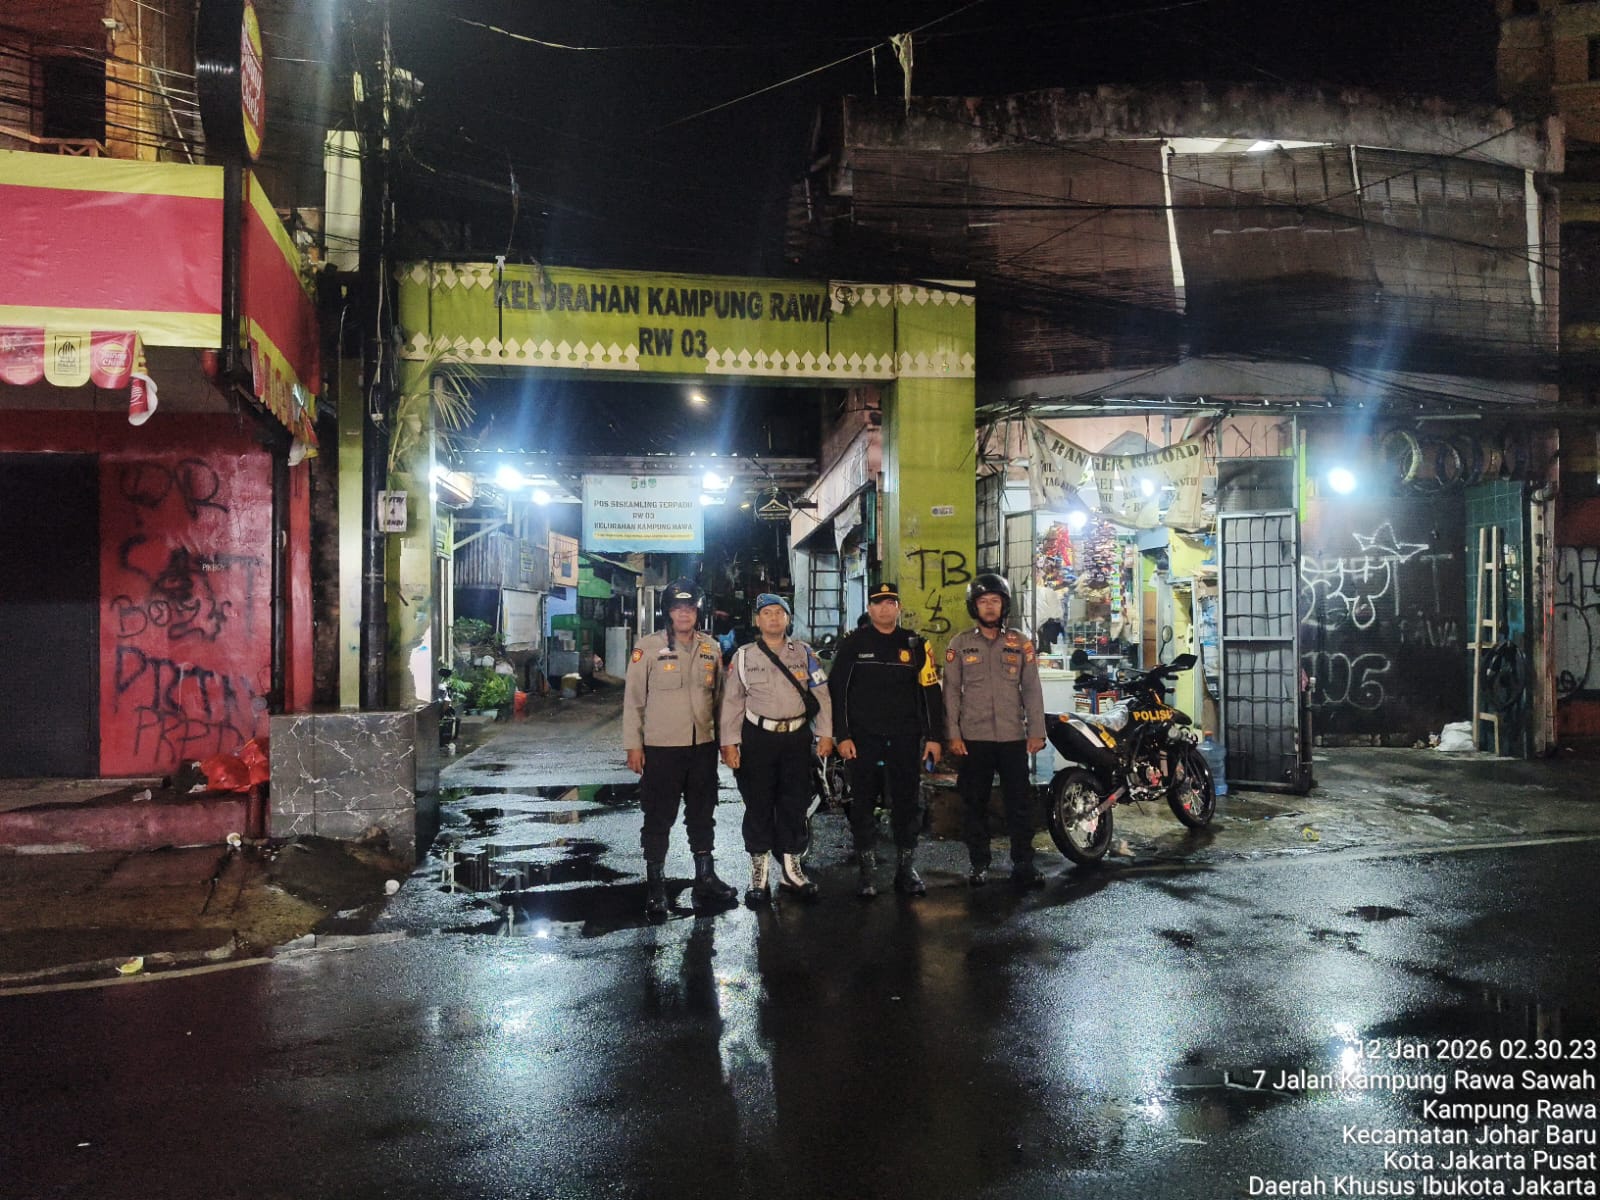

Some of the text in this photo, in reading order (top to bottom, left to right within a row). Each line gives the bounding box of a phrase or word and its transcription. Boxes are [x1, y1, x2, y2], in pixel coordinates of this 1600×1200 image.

[494, 279, 832, 322] KELURAHAN KAMPUNG RAWA
[638, 327, 708, 359] RW 03
[594, 500, 693, 509] POS SISKAMLING TERPADU
[632, 512, 655, 520] RW 03
[594, 522, 636, 530] KELURAHAN
[637, 522, 671, 530] KAMPUNG
[906, 547, 972, 592] TB
[1133, 709, 1173, 722] POLISI
